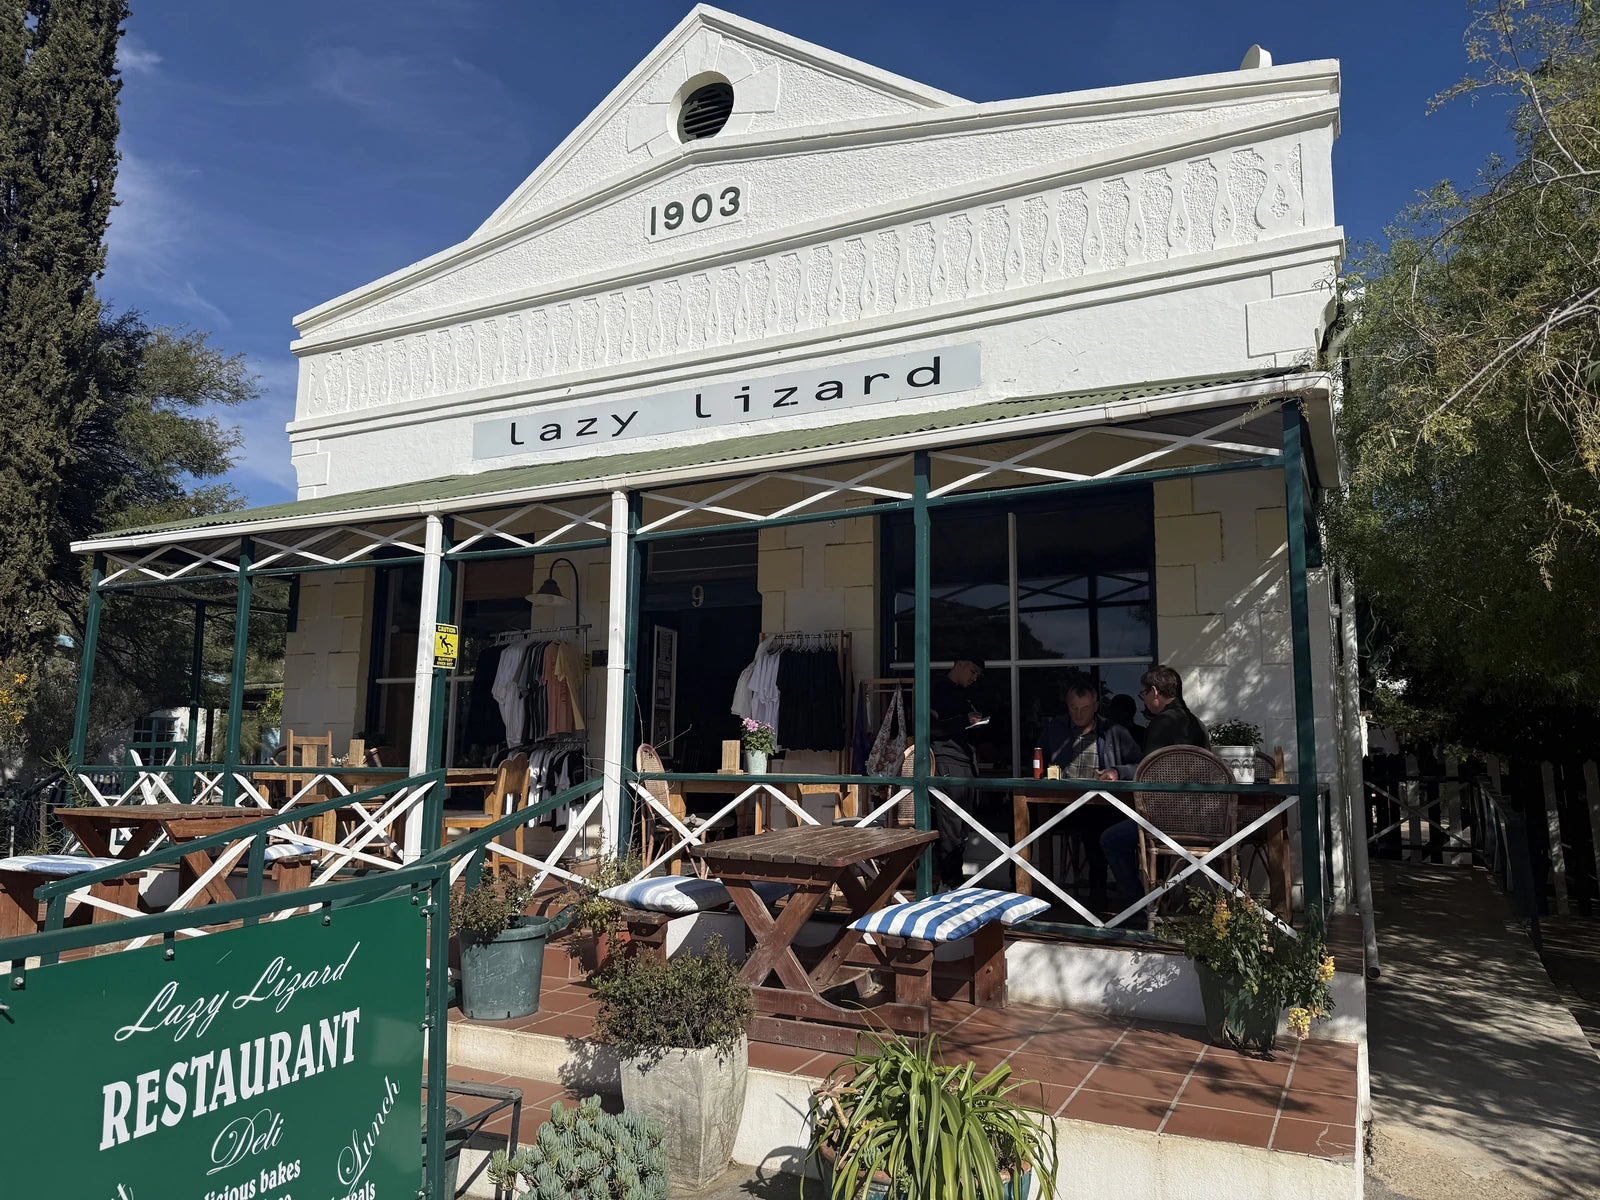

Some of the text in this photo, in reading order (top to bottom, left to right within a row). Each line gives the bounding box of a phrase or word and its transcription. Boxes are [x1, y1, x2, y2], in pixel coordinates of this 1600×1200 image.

[650, 186, 741, 236] 1903
[510, 355, 941, 446] lazy lizard
[691, 584, 704, 608] 9
[114, 941, 361, 1043] Lazy Lizard
[99, 1006, 361, 1152] RESTAURANT
[205, 1107, 285, 1176] Deli
[260, 1159, 301, 1193] bakes
[337, 1075, 401, 1198] Lunch
